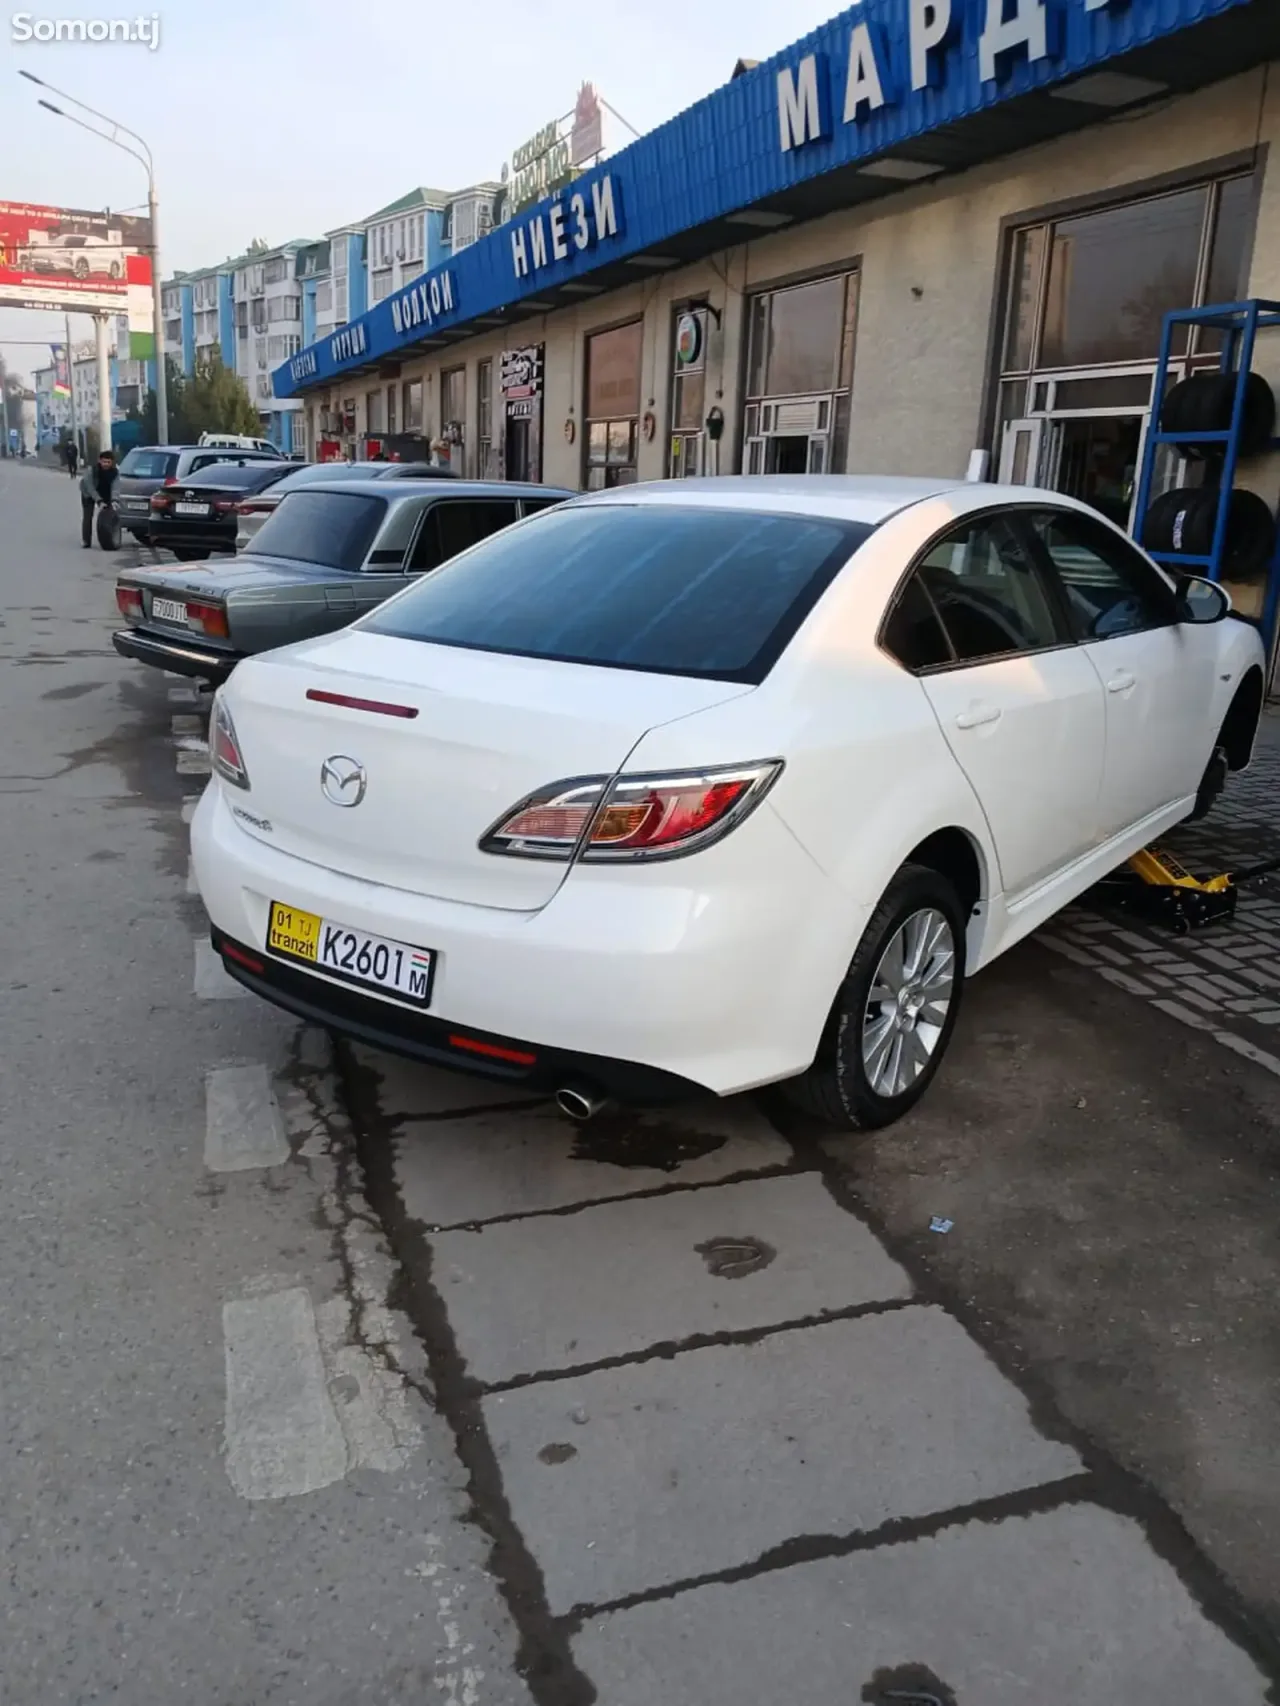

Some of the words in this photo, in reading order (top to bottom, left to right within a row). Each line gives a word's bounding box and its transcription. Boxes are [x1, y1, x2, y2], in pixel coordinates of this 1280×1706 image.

[392, 270, 454, 333] МОЛҲОИ
[511, 175, 617, 277] НИЁЗИ
[776, 0, 1111, 153] МАРД
[271, 930, 315, 959] tranzit
[276, 910, 293, 930] 01
[299, 919, 312, 937] TJ
[323, 926, 404, 986] K2601
